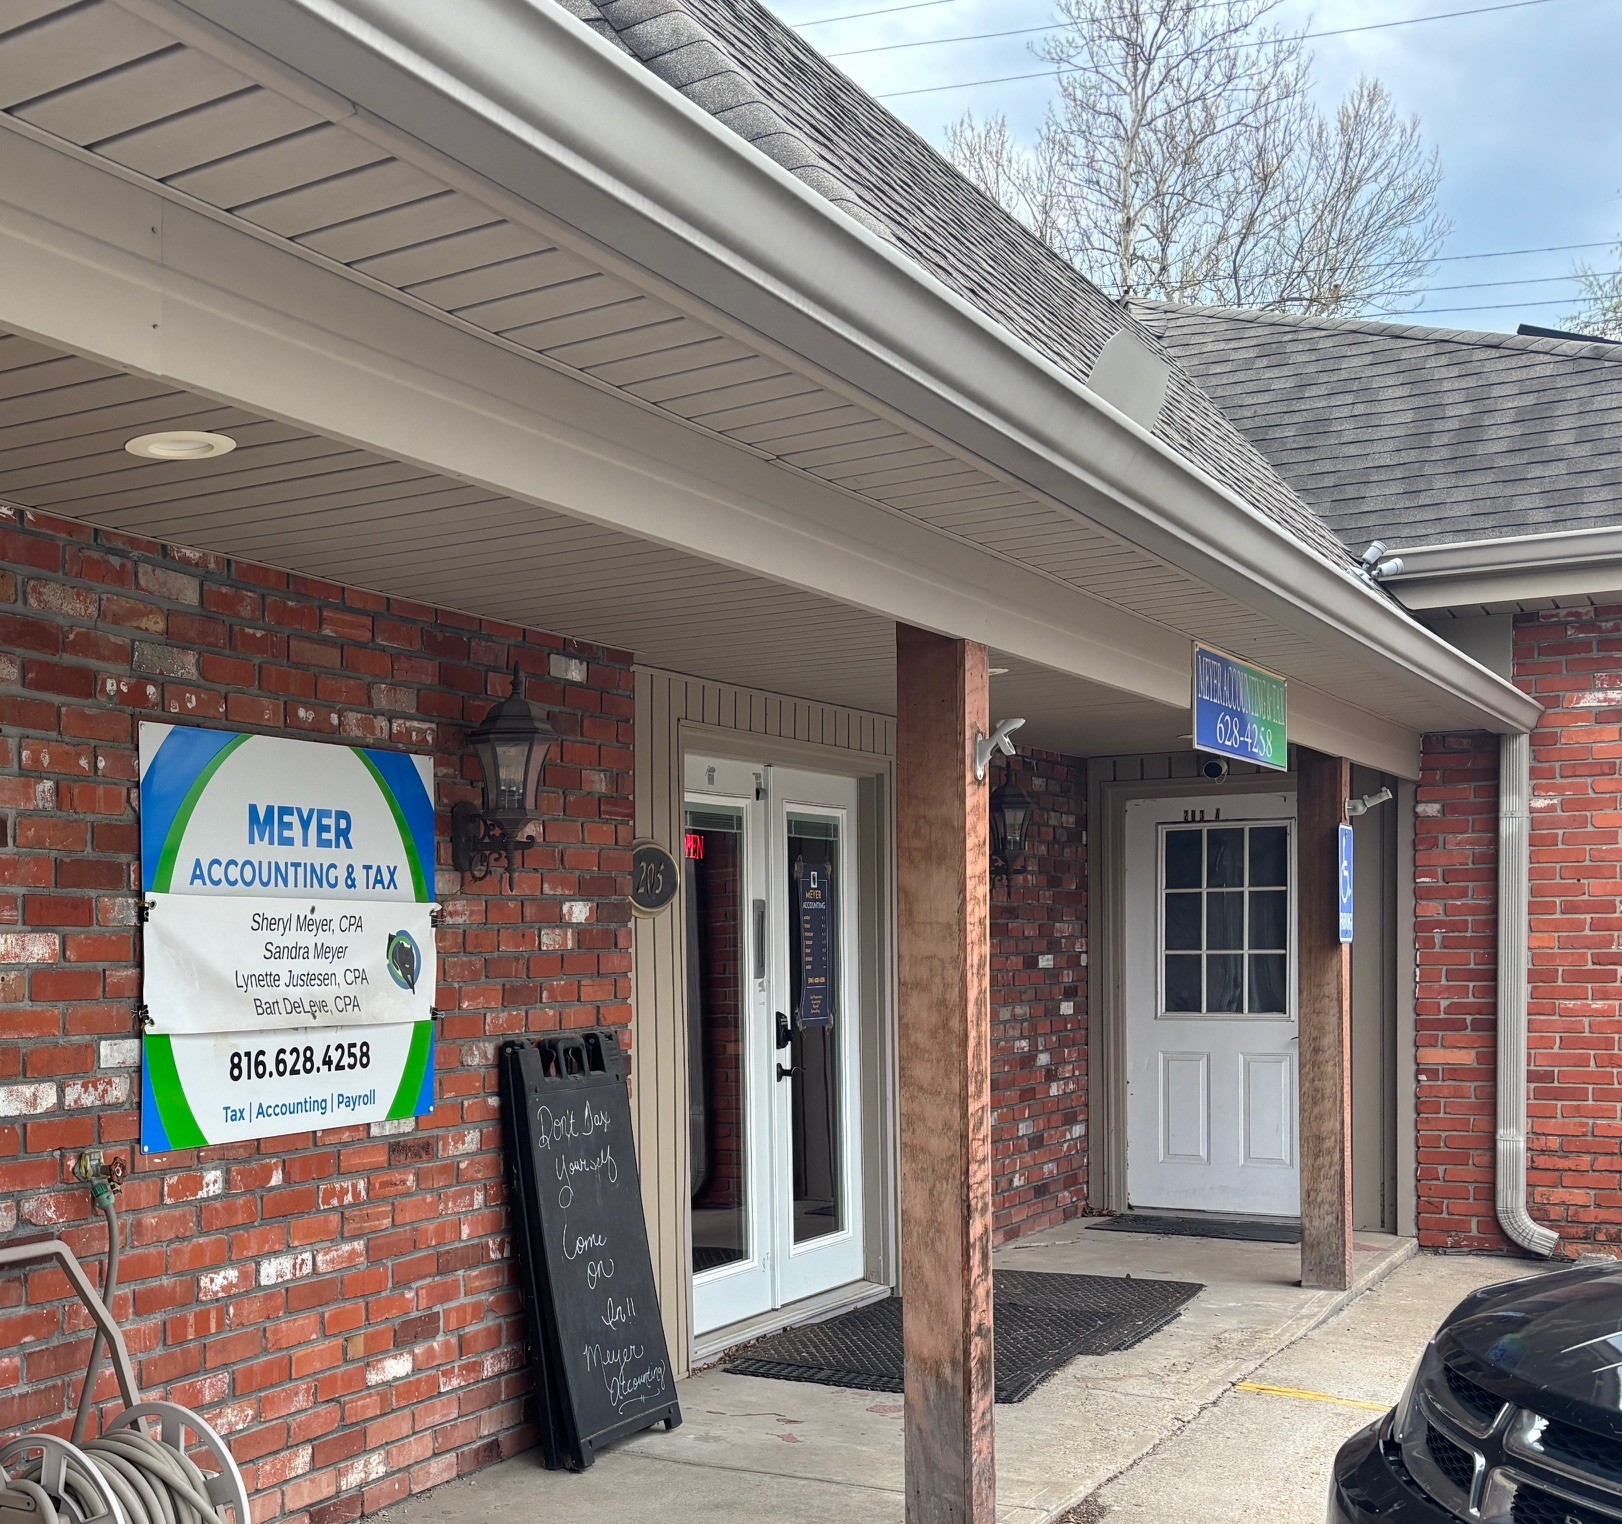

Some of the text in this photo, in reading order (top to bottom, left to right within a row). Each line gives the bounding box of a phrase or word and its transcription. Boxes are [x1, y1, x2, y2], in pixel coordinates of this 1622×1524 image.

[1198, 655, 1222, 704] MEYER
[1216, 711, 1273, 758] 628-4258
[248, 803, 353, 850] MEYER
[684, 833, 704, 859] PEN
[189, 858, 398, 890] ACCOUNTING & TAX
[806, 890, 822, 899] MEYER
[250, 912, 363, 937] Sheryl Meyer, CPA
[263, 941, 348, 964] Sandra Meyer
[235, 968, 369, 993] Lynette Justesen, CPA
[253, 995, 361, 1016] Bart DeLeve, CPA
[229, 1040, 371, 1082] 816.628.4258
[222, 1105, 246, 1123] Tax
[255, 1096, 328, 1119] Accounting
[337, 1088, 376, 1111] Payroll
[537, 1105, 579, 1150] Don't
[563, 1224, 607, 1260] Come
[583, 1343, 644, 1383] Meyer
